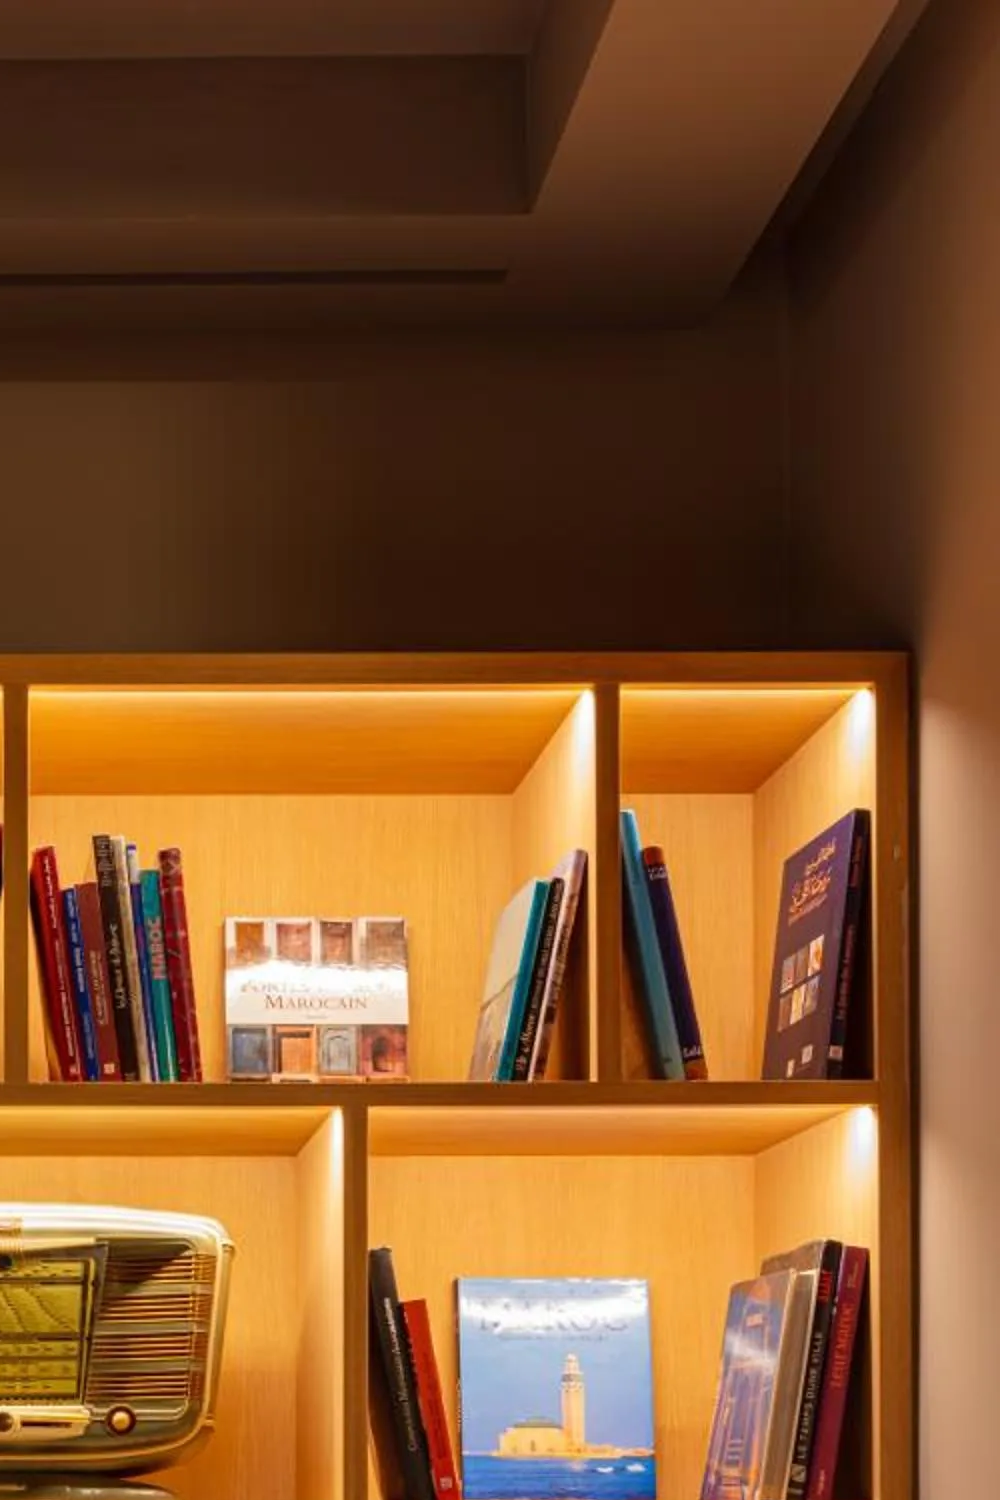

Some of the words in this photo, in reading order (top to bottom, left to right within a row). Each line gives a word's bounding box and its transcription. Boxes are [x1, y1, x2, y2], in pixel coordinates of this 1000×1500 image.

[145, 916, 167, 980] MAROC
[265, 995, 368, 1009] MAROCAIN
[797, 1401, 813, 1440] TEMPS
[795, 1445, 807, 1459] LE
